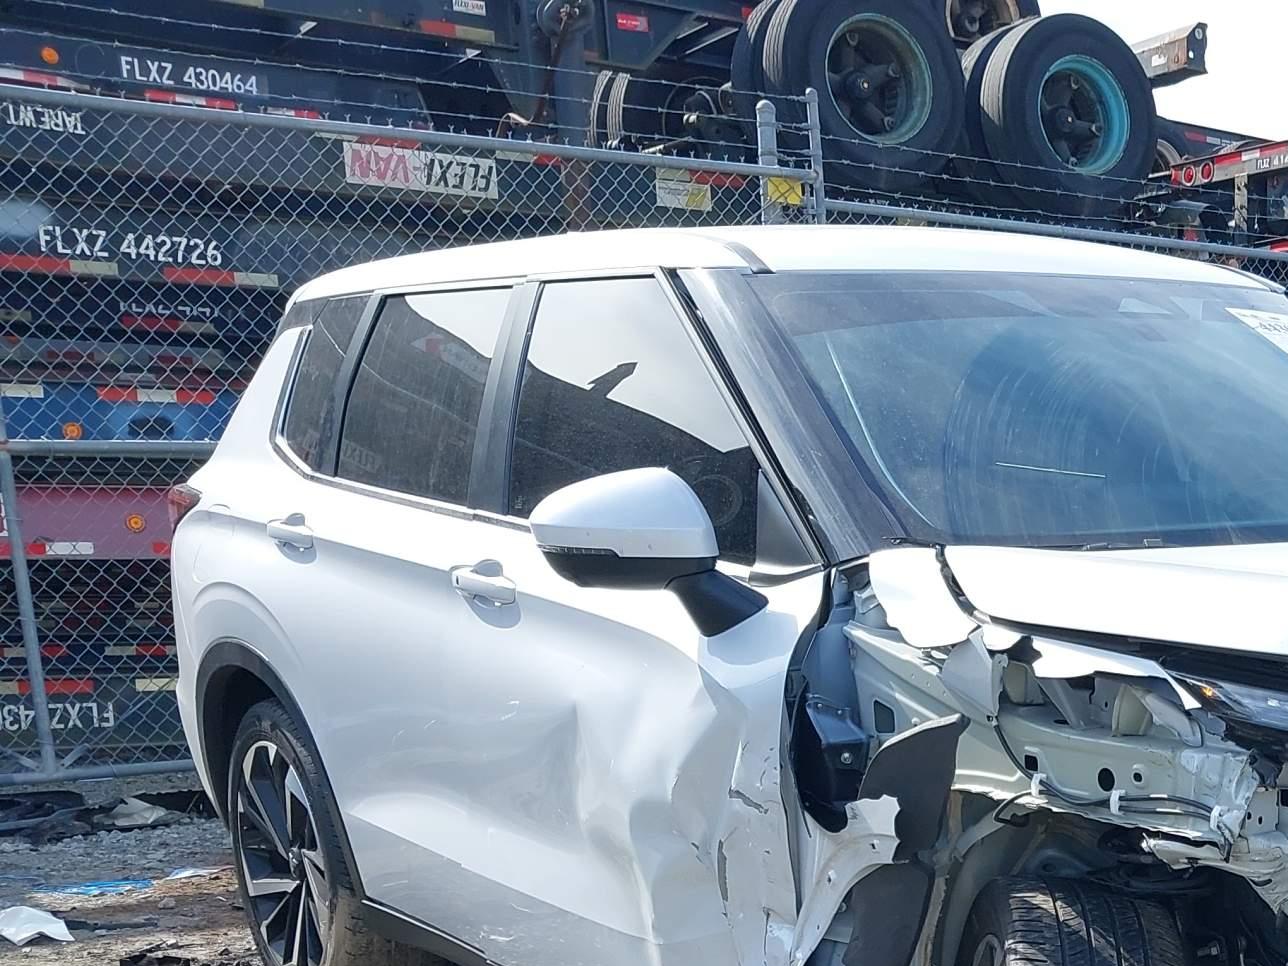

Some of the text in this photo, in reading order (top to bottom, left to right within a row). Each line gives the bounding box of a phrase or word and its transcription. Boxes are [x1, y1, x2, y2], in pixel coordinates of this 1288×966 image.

[120, 56, 258, 96] FLXZ 430464
[350, 149, 494, 193] FLEXI-VAN
[38, 225, 222, 266] FLXZ 442726
[47, 702, 115, 729] FLXZ
